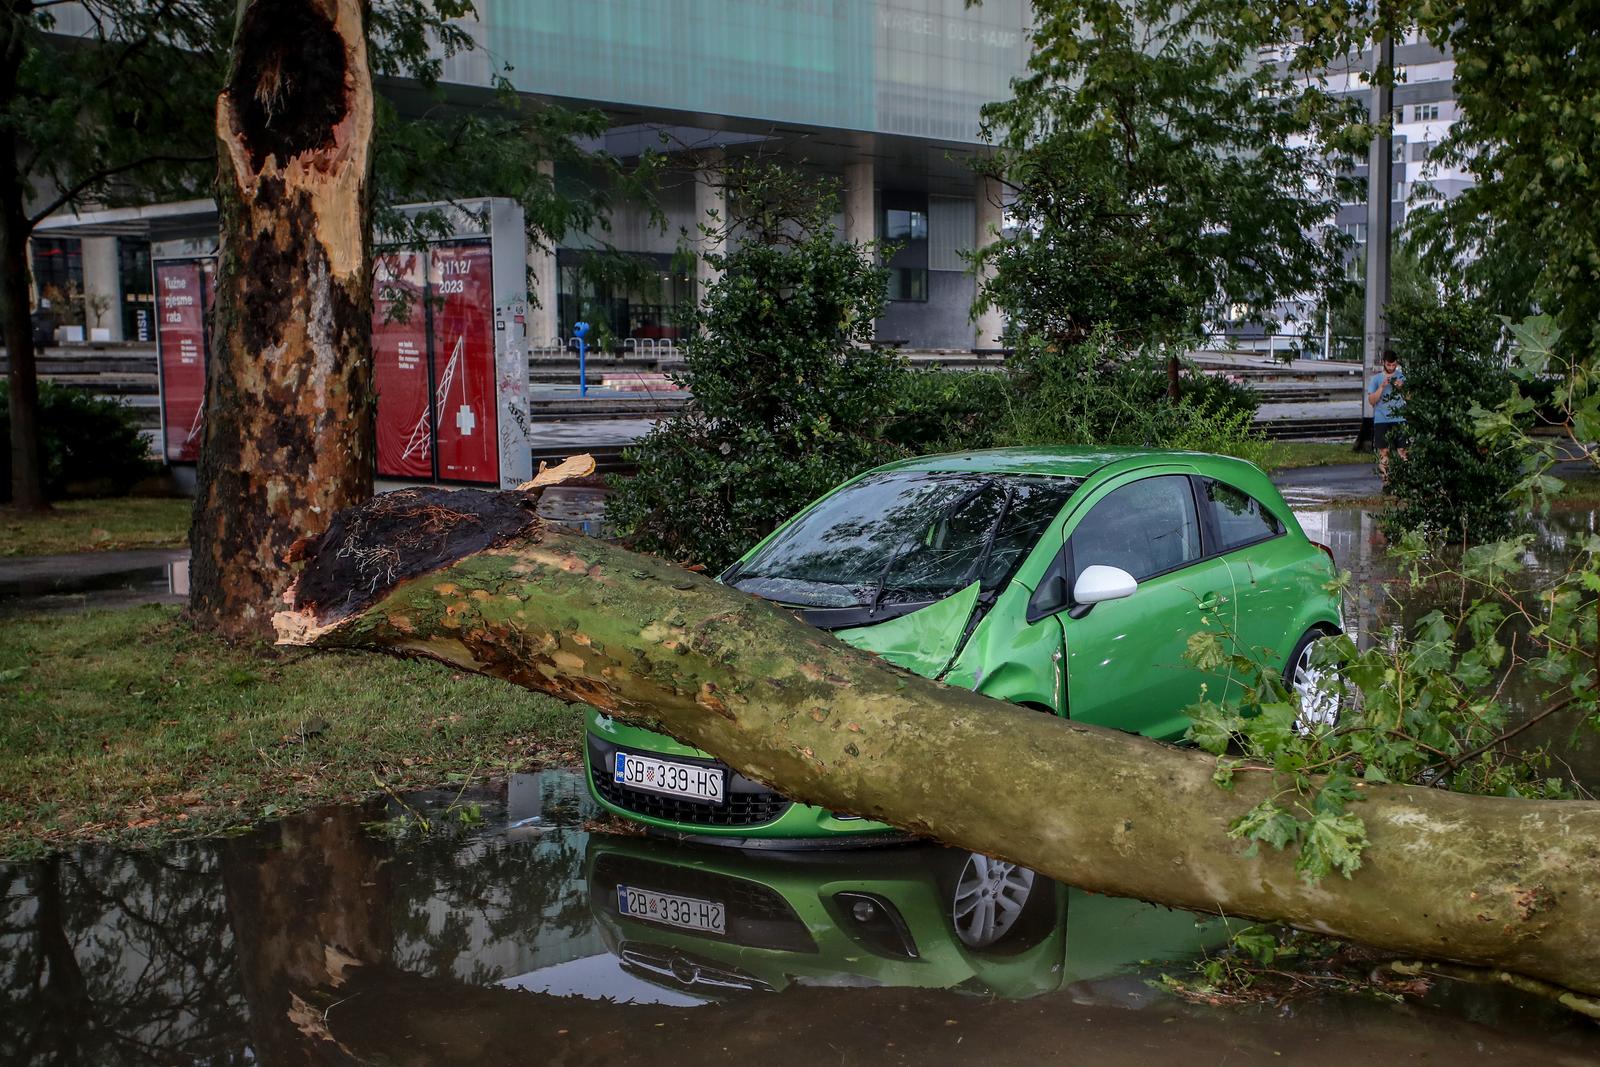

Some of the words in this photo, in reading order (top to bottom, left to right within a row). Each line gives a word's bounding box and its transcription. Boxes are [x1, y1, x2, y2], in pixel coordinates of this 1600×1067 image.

[438, 260, 471, 275] 31/12/
[439, 280, 463, 294] 2023
[165, 294, 193, 308] pjesme
[166, 311, 182, 322] rata
[136, 309, 148, 342] msu
[626, 759, 645, 783] SB
